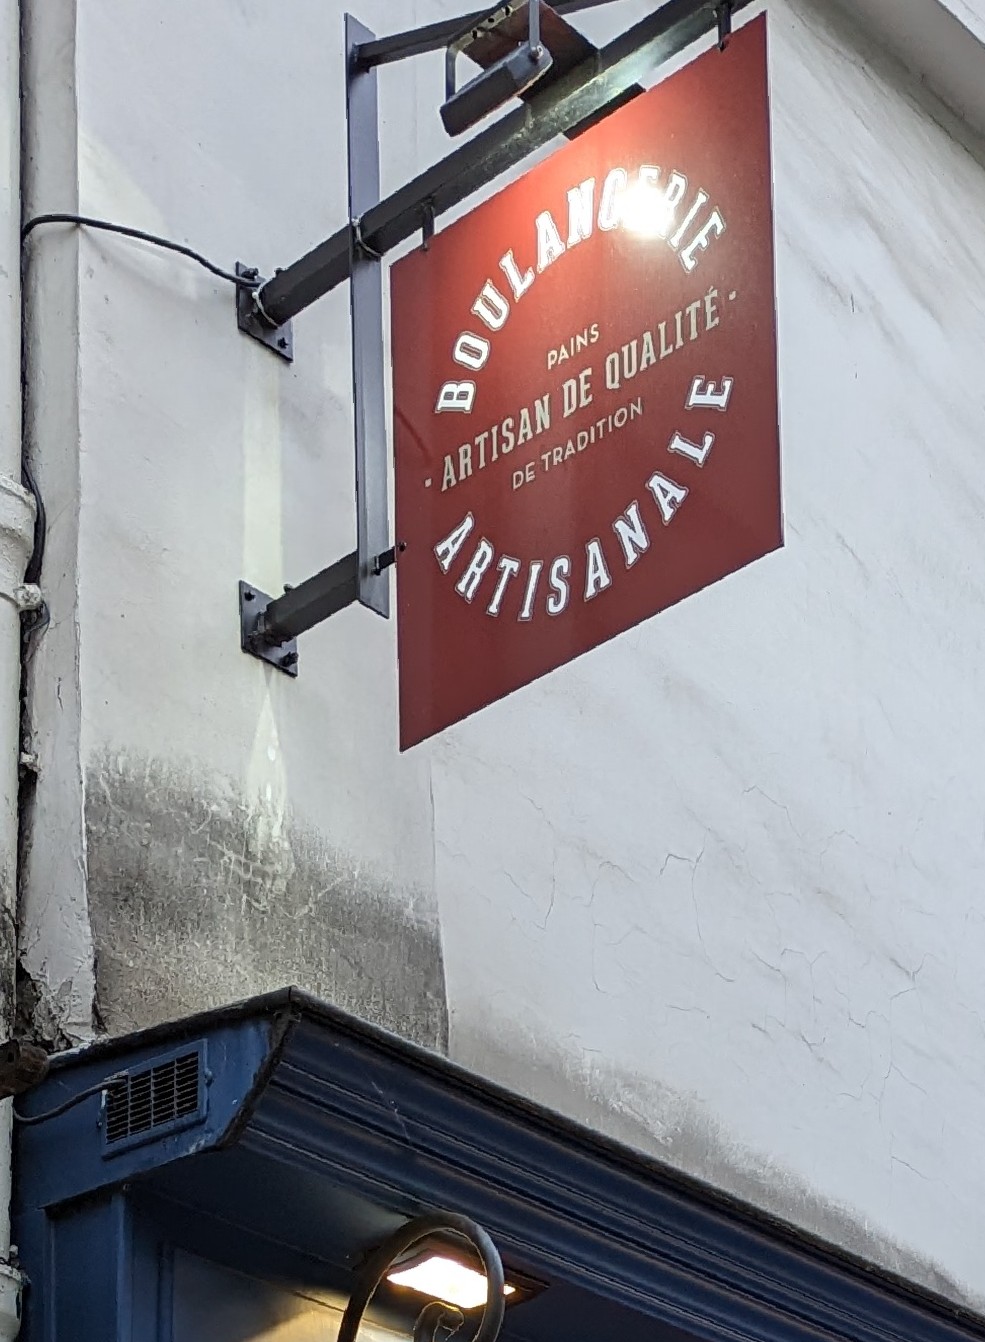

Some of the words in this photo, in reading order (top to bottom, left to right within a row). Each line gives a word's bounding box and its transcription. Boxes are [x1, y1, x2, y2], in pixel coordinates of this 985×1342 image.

[440, 393, 552, 491] ARTISAN
[562, 366, 593, 415] DE
[604, 285, 721, 392] QUALITÉ
[546, 323, 600, 370] PAINS
[433, 374, 733, 623] ARTISANALE
[511, 461, 536, 491] DE
[541, 397, 643, 476] TRADITION
